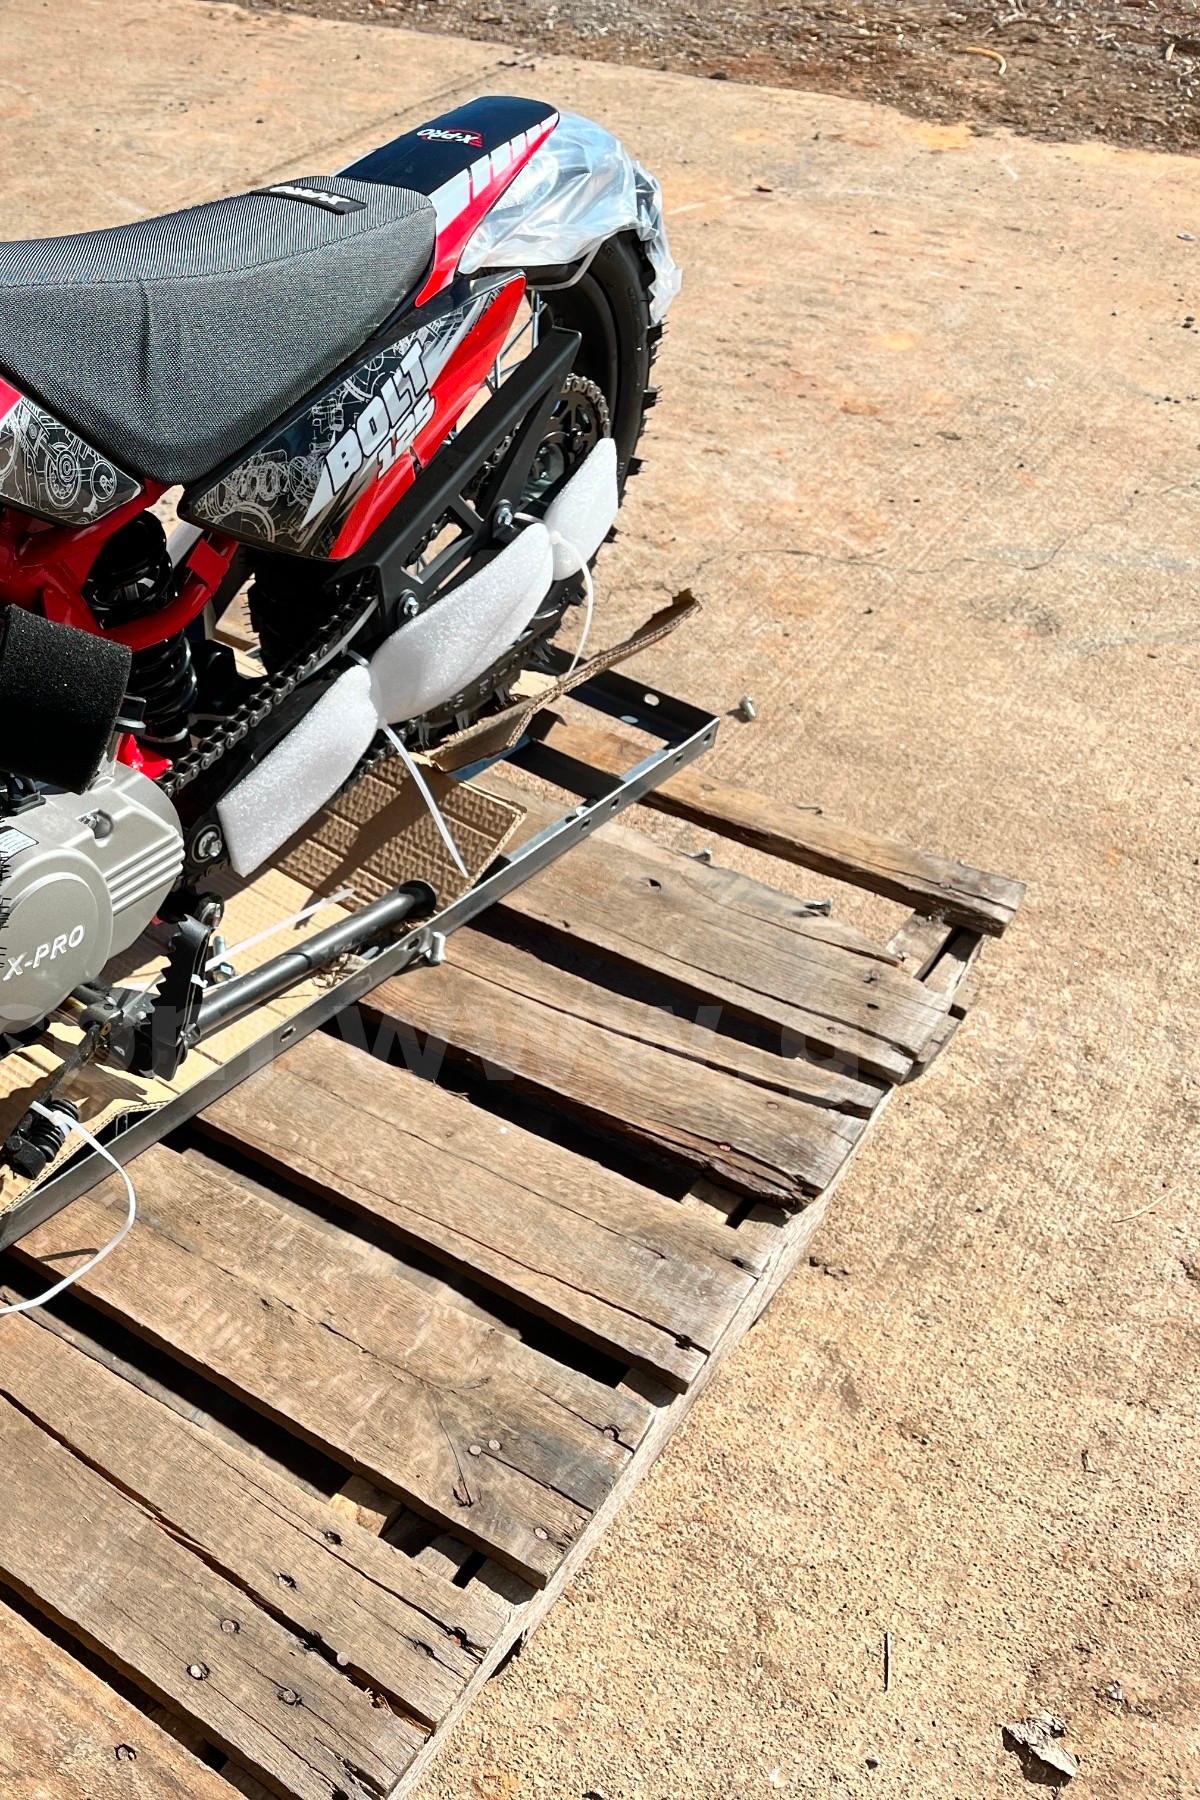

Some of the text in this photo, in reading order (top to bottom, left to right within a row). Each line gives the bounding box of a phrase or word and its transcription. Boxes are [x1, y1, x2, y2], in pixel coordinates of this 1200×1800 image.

[416, 127, 480, 145] X-PRO
[324, 338, 429, 496] BOLT
[377, 389, 437, 481] 125
[2, 924, 85, 982] X-PRO
